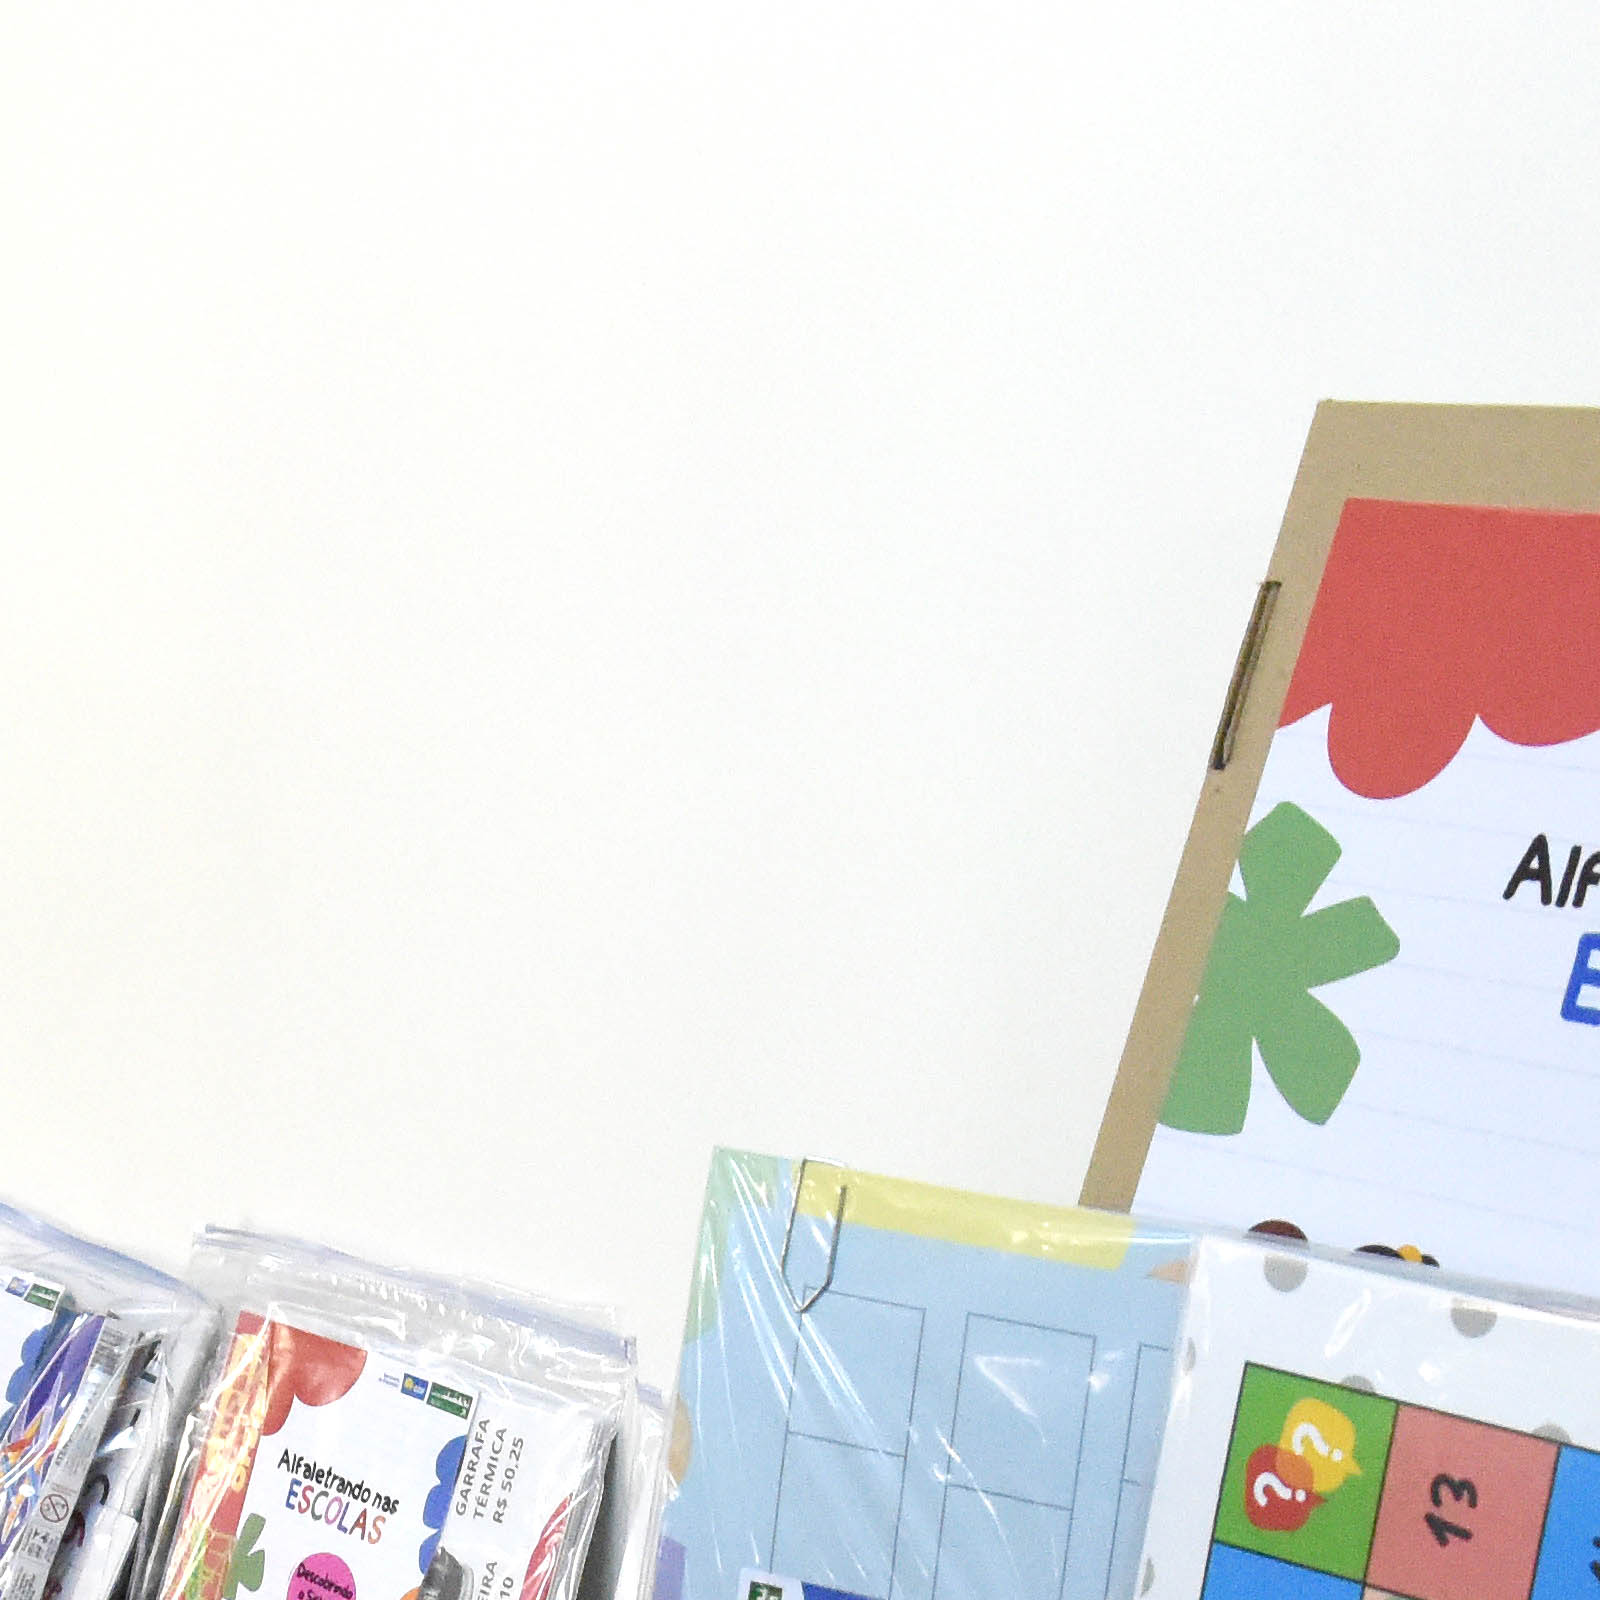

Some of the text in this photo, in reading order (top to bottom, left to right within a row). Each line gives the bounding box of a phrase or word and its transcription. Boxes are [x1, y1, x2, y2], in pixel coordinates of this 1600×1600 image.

[276, 1446, 401, 1517] Alfaletrando nas
[454, 1416, 492, 1517] GARRAFA
[472, 1426, 508, 1521] TÉRMICA
[284, 1477, 387, 1545] ESCOLAS
[491, 1496, 509, 1525] R$
[1422, 1472, 1479, 1548] 13
